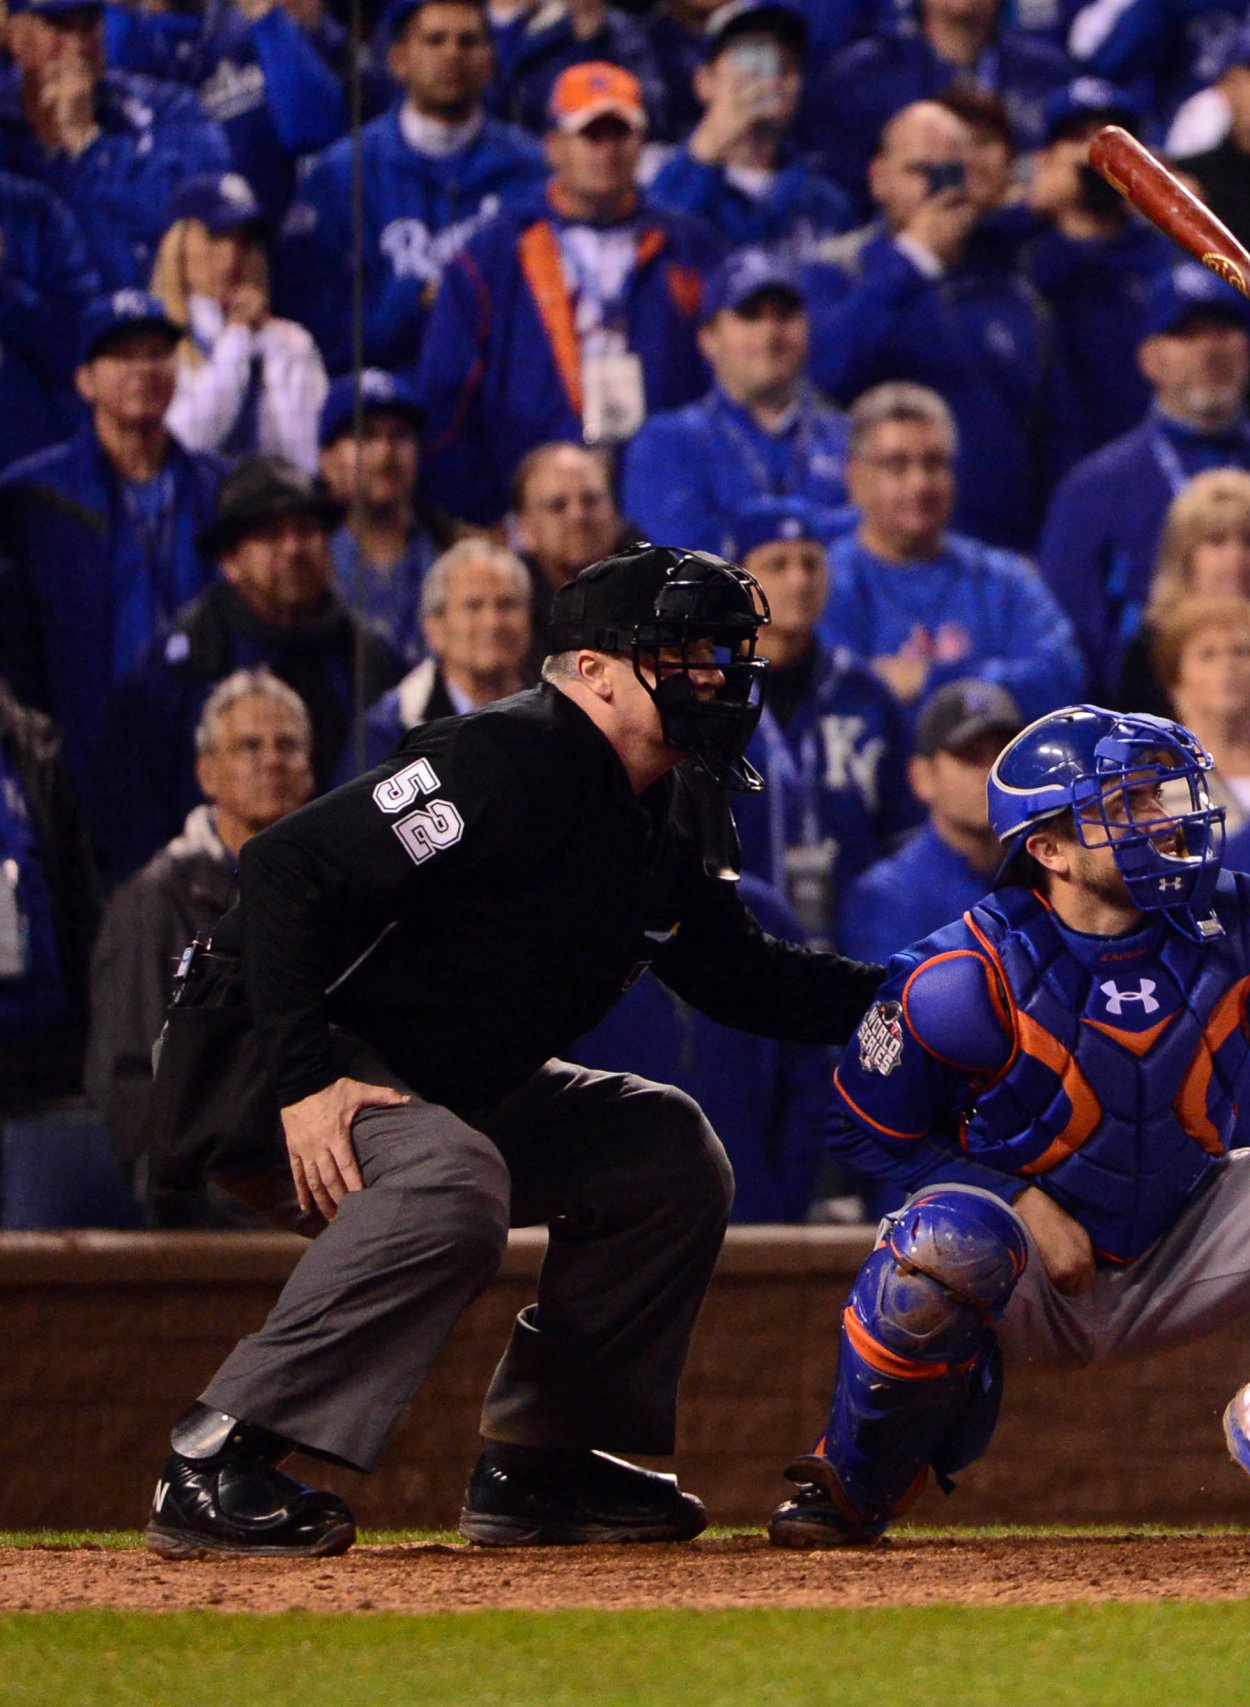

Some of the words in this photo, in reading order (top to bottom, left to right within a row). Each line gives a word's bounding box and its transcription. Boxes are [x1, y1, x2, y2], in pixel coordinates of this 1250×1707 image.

[372, 757, 465, 865] 52
[857, 1020, 893, 1073] SERIES
[867, 1006, 901, 1058] WORLD
